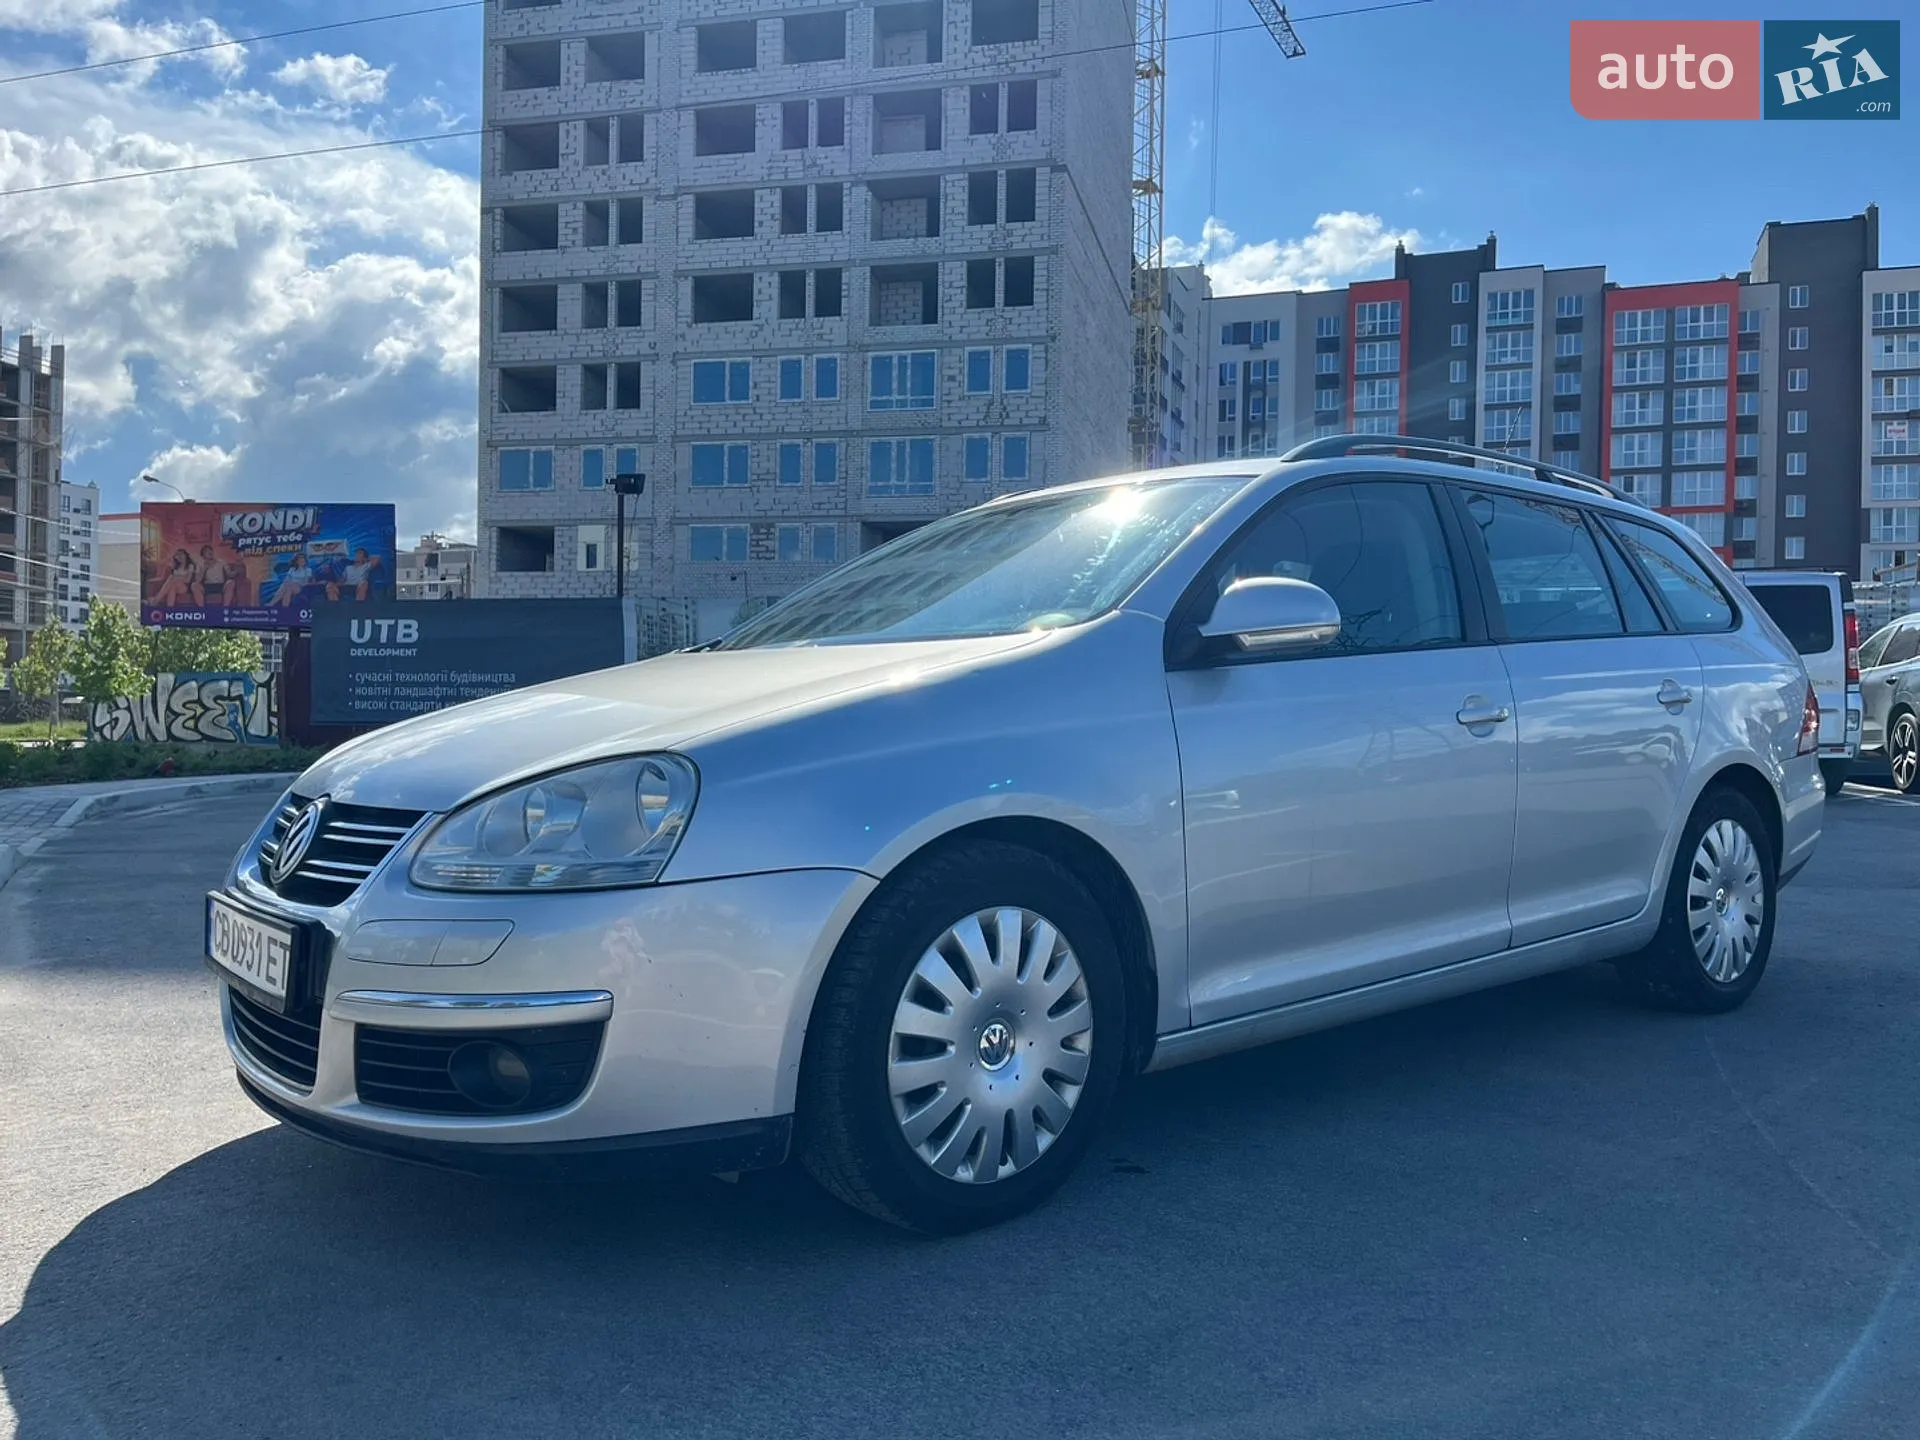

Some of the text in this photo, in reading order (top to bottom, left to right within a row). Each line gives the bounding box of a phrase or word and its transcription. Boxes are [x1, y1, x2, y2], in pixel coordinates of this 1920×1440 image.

[222, 508, 314, 535] KONDI
[276, 532, 304, 543] тебе
[165, 612, 206, 621] KONDI
[350, 618, 419, 644] UTB
[350, 647, 418, 657] DEVELOPMENT
[355, 670, 515, 685] сучасні технології будівництва
[355, 684, 391, 696] новітні
[394, 684, 457, 698] ландшафтні
[354, 698, 387, 710] високі
[390, 700, 442, 712] стандарти
